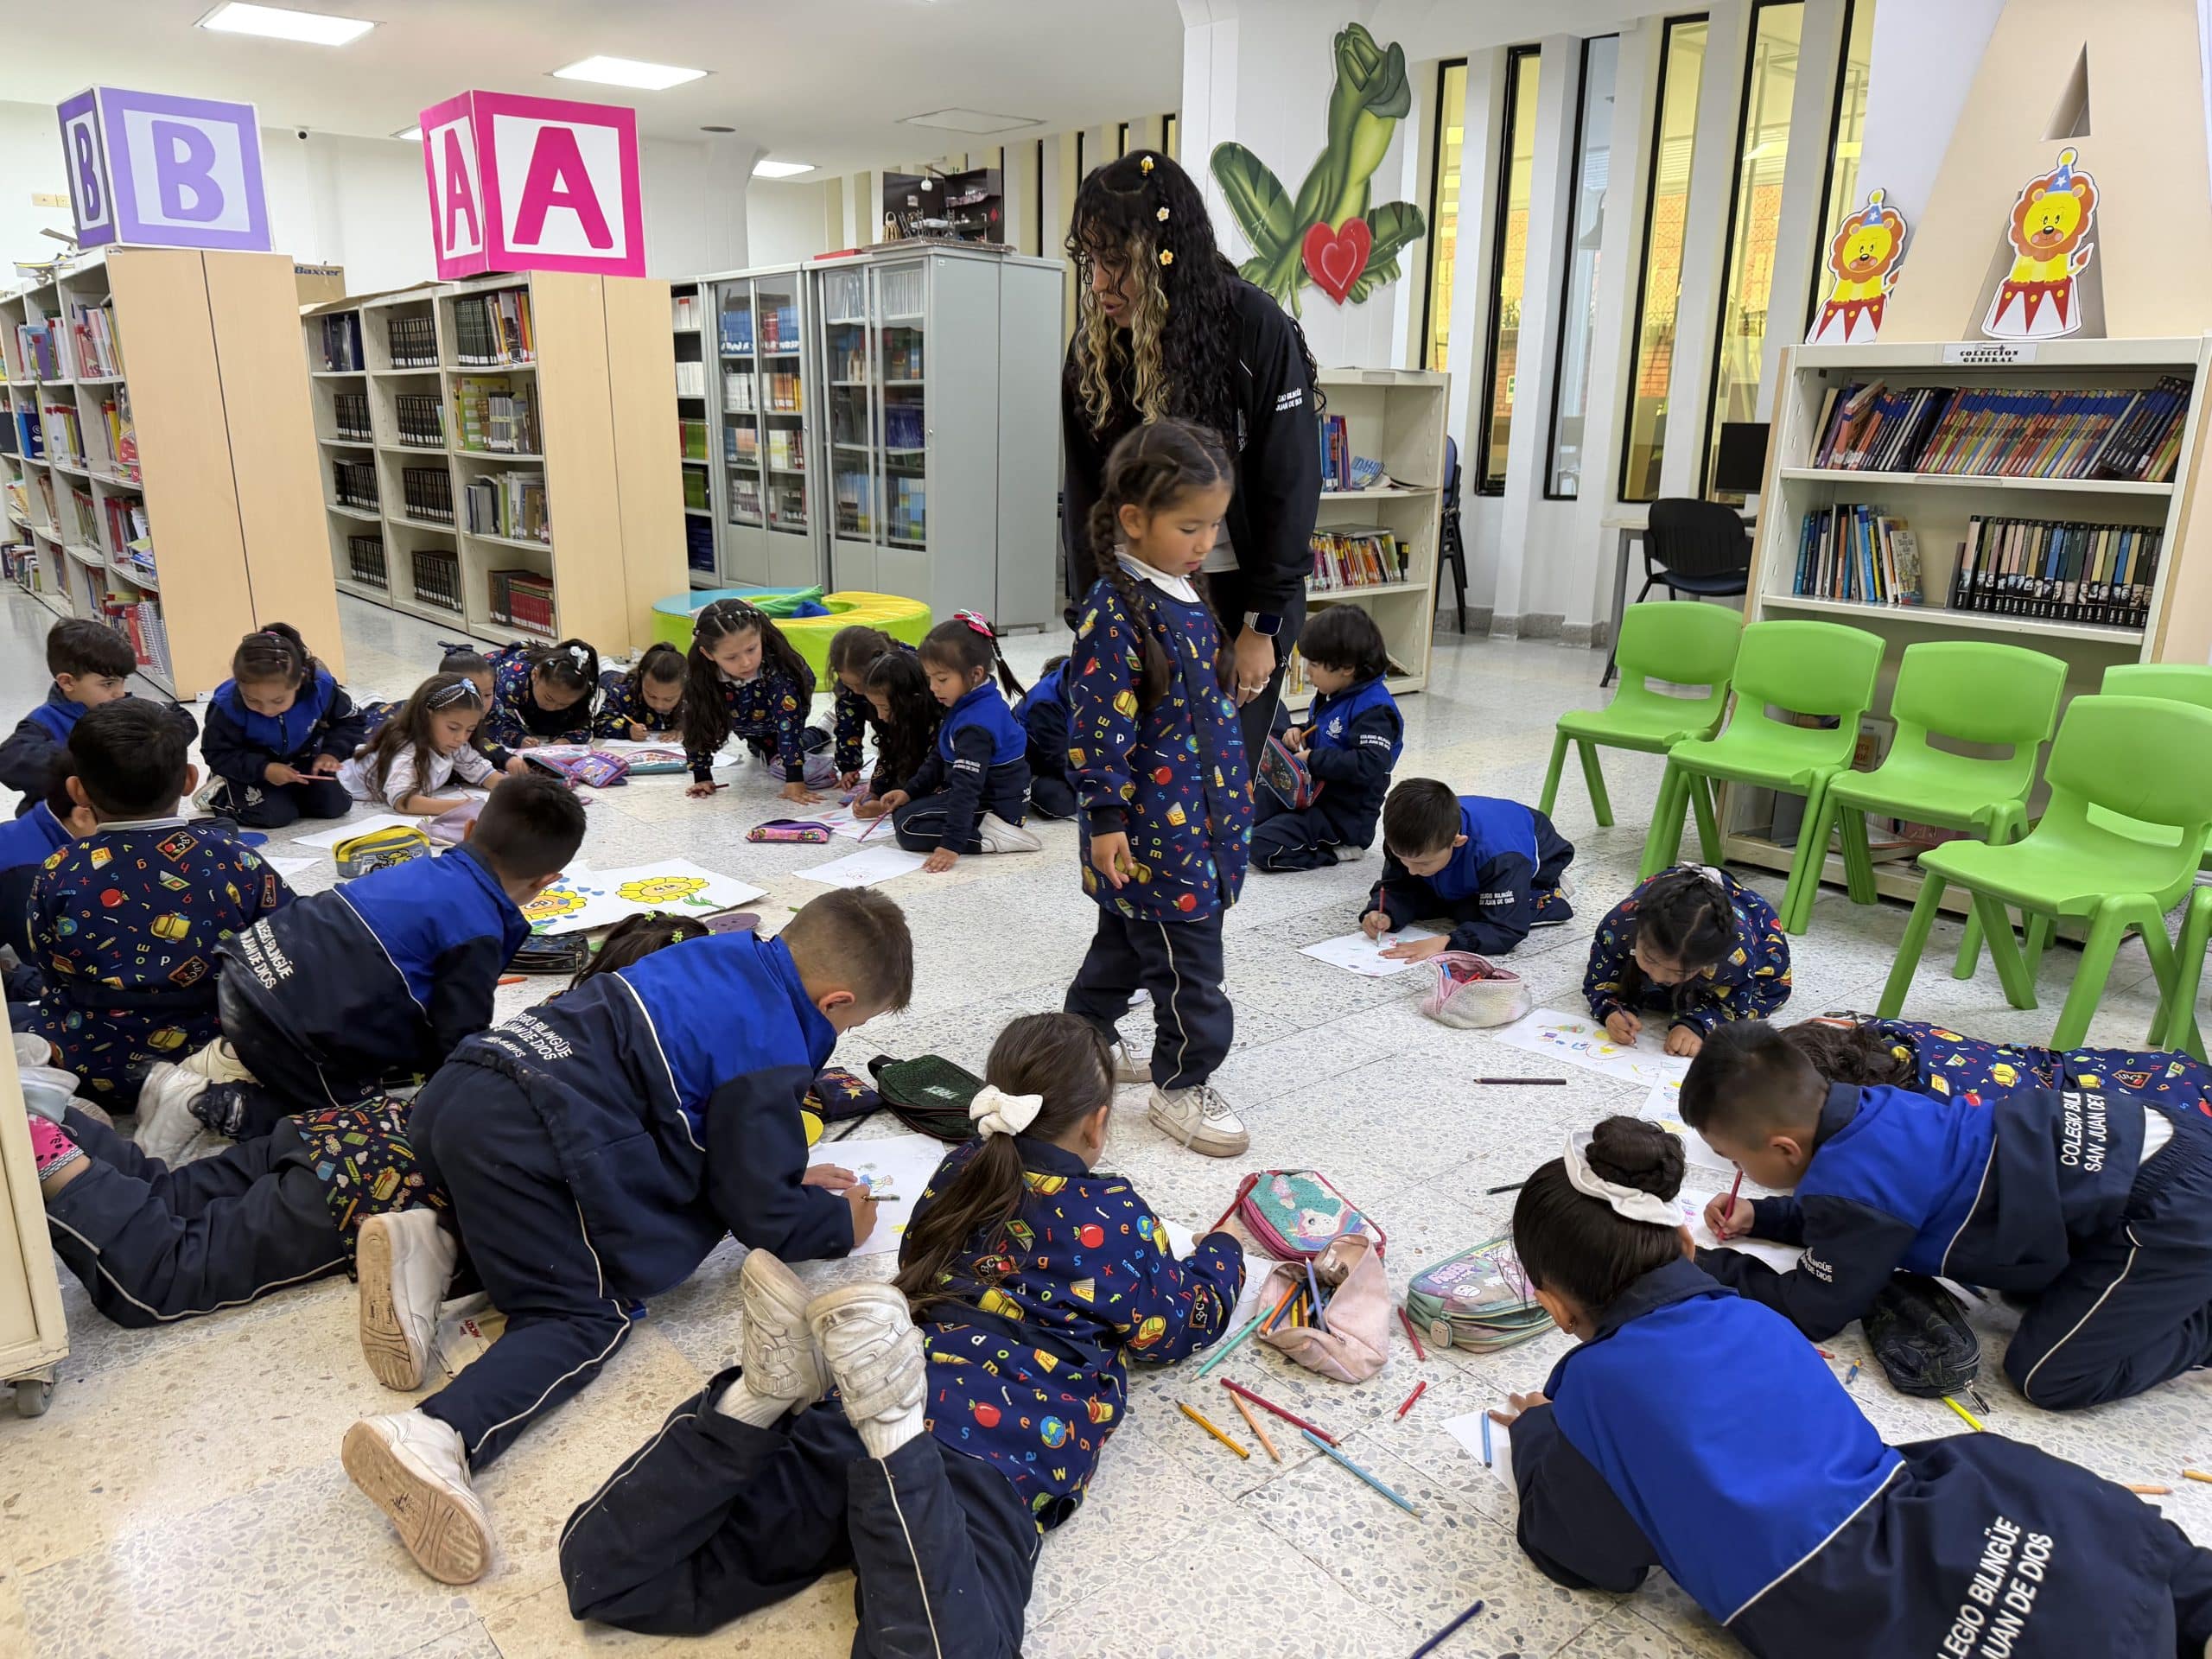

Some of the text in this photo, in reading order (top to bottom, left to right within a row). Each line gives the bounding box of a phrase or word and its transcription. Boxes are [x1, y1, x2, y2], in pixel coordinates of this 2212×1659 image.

[73, 122, 100, 221] B
[151, 119, 225, 223] B
[444, 127, 480, 252] A
[512, 126, 614, 250] A
[254, 962, 276, 988] DIOS
[518, 1029, 538, 1042] DE
[530, 1039, 557, 1060] DIOS
[531, 1021, 574, 1058] BILINGÜE
[2060, 1109, 2083, 1166] COLEGIO
[2088, 1112, 2107, 1142] JUAN
[2083, 1146, 2107, 1173] SAN
[1967, 1516, 2021, 1607] BILINGÜE
[2017, 1532, 2055, 1583] DIOS
[2005, 1577, 2038, 1615] DE
